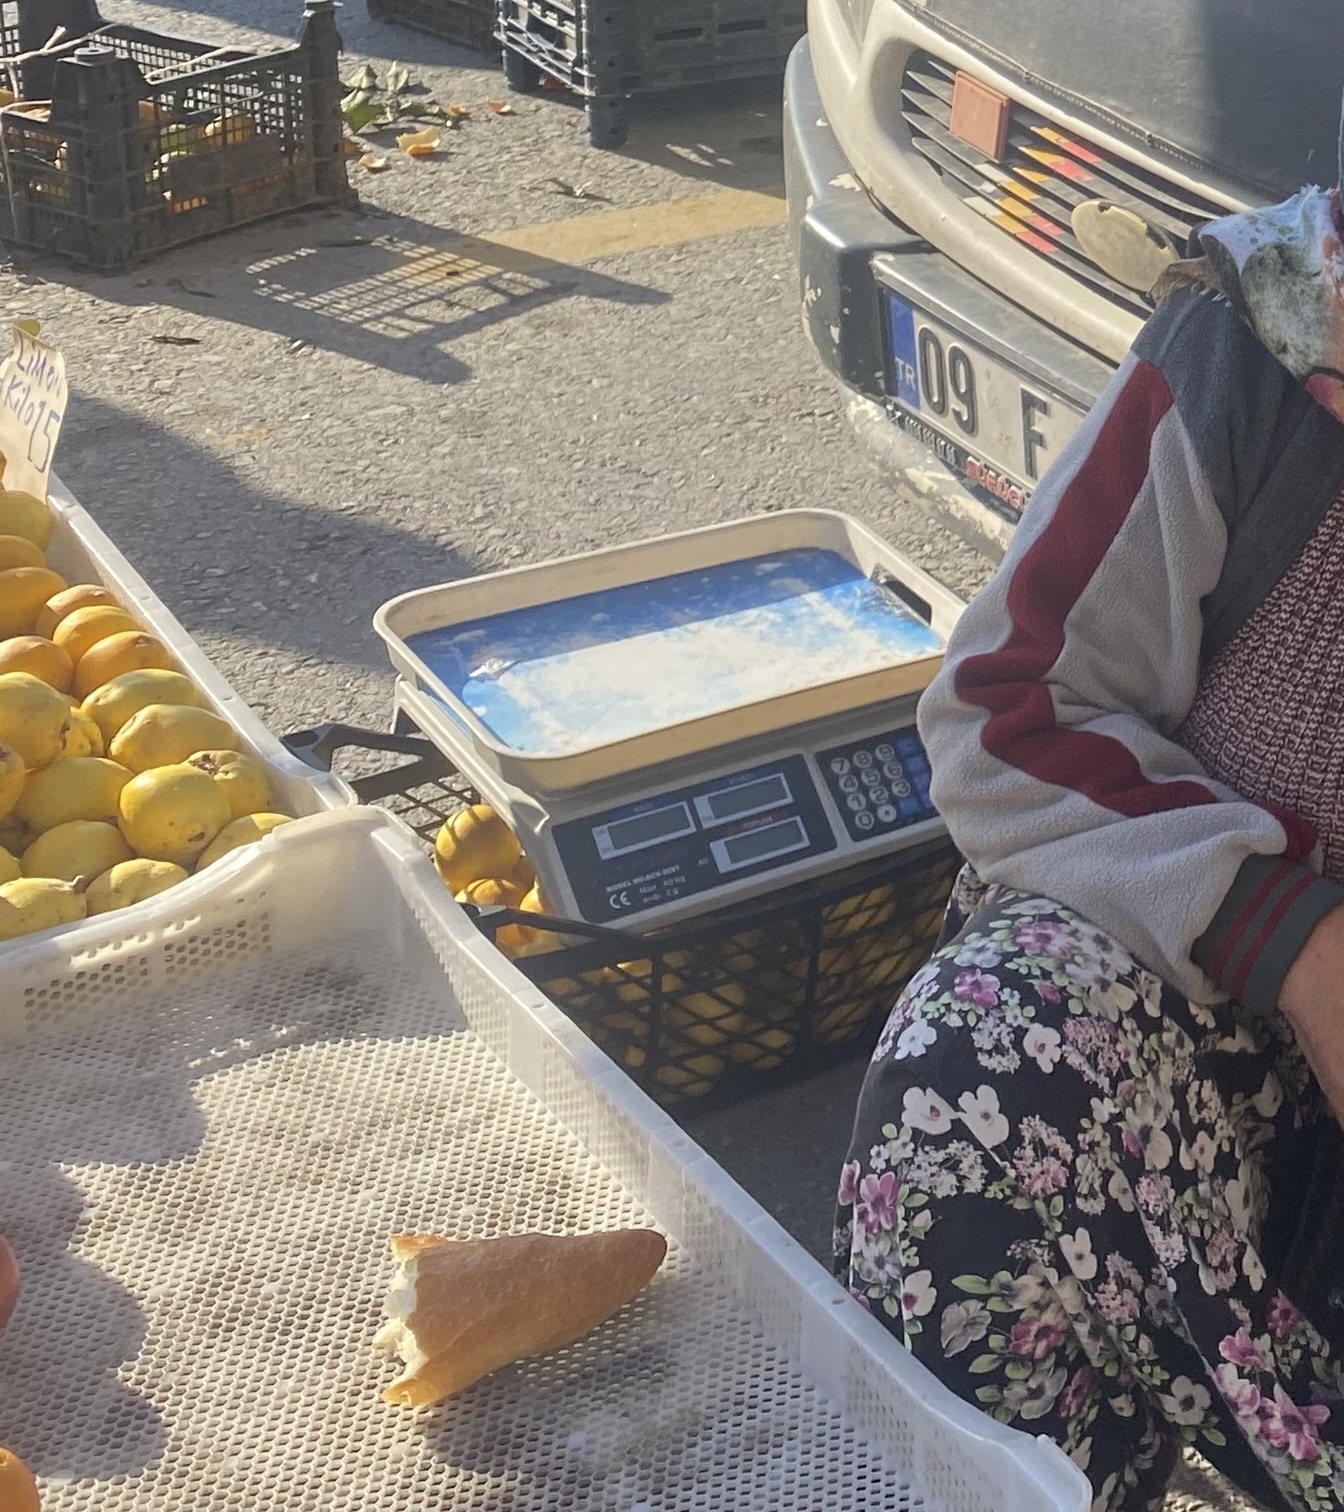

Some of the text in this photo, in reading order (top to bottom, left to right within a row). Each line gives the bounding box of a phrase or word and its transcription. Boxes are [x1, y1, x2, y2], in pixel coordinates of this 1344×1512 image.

[894, 356, 917, 393] TR
[917, 325, 978, 437] 09
[1020, 385, 1050, 482] F
